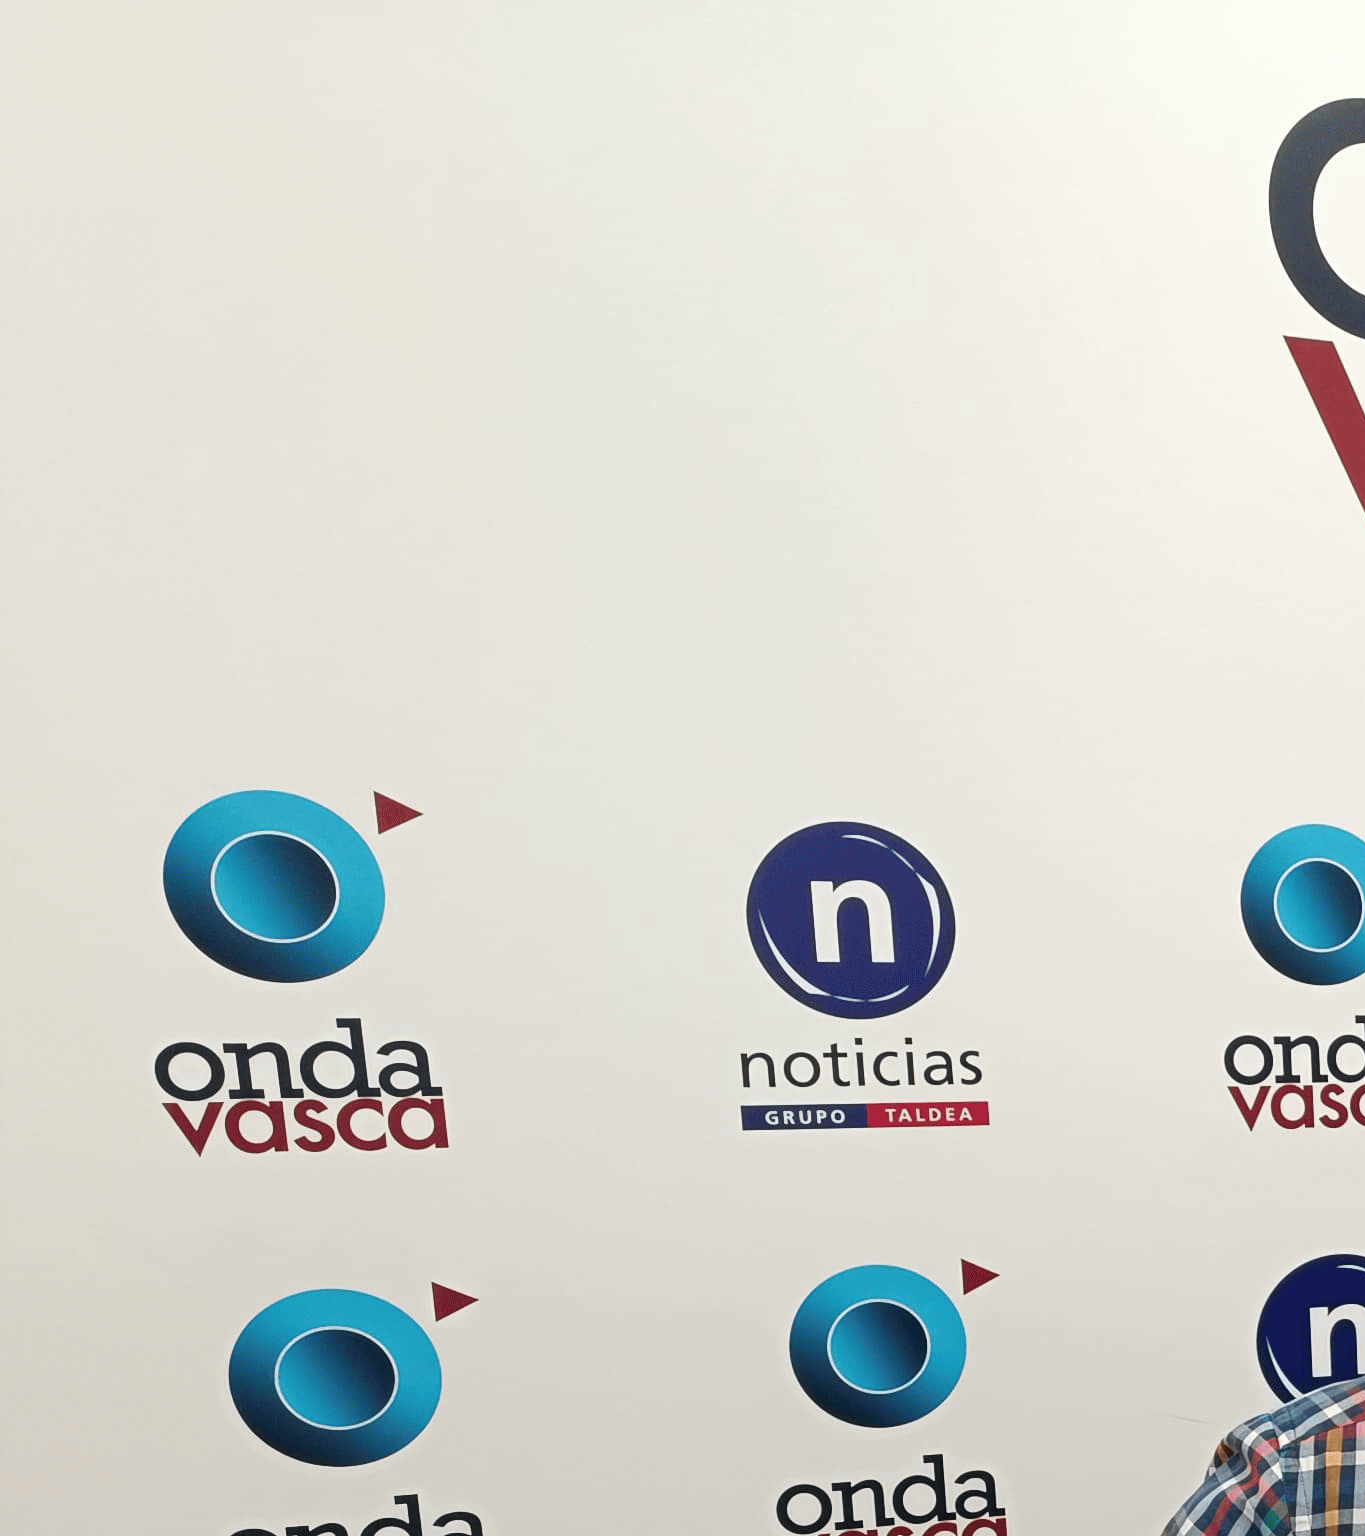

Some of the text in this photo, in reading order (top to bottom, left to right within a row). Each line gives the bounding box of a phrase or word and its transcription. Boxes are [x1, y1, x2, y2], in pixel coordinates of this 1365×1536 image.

[154, 1018, 443, 1101] onda
[740, 1037, 983, 1088] noticias
[162, 1096, 449, 1157] vasca
[763, 1107, 973, 1126] GRUPO TALDEA
[775, 1454, 1006, 1535] onda
